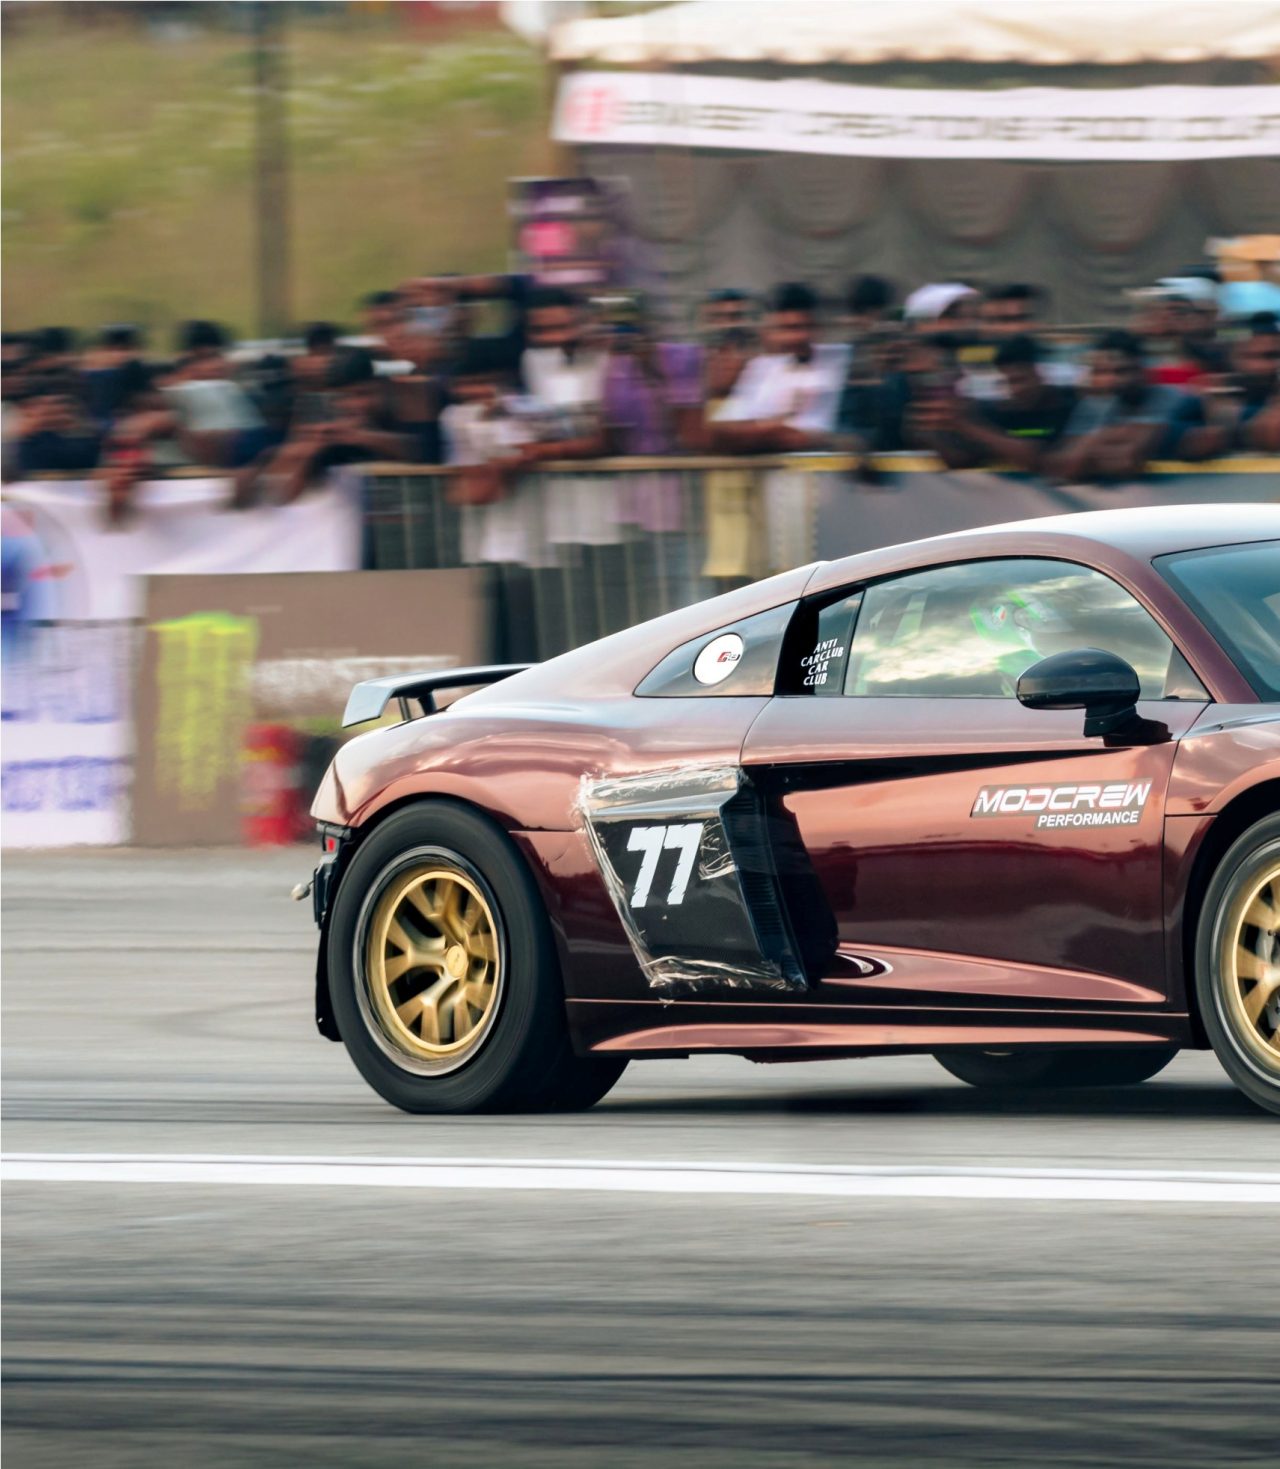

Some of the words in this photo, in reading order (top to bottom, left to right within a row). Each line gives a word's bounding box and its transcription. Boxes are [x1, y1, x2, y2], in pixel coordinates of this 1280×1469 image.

[813, 638, 838, 654] ANTI
[800, 646, 844, 667] CARCLUB
[808, 660, 829, 675] CAR
[803, 672, 828, 686] CLUB
[973, 783, 1152, 813] MODCREW
[1038, 811, 1140, 828] PERFORMANCE
[626, 822, 703, 908] 77
